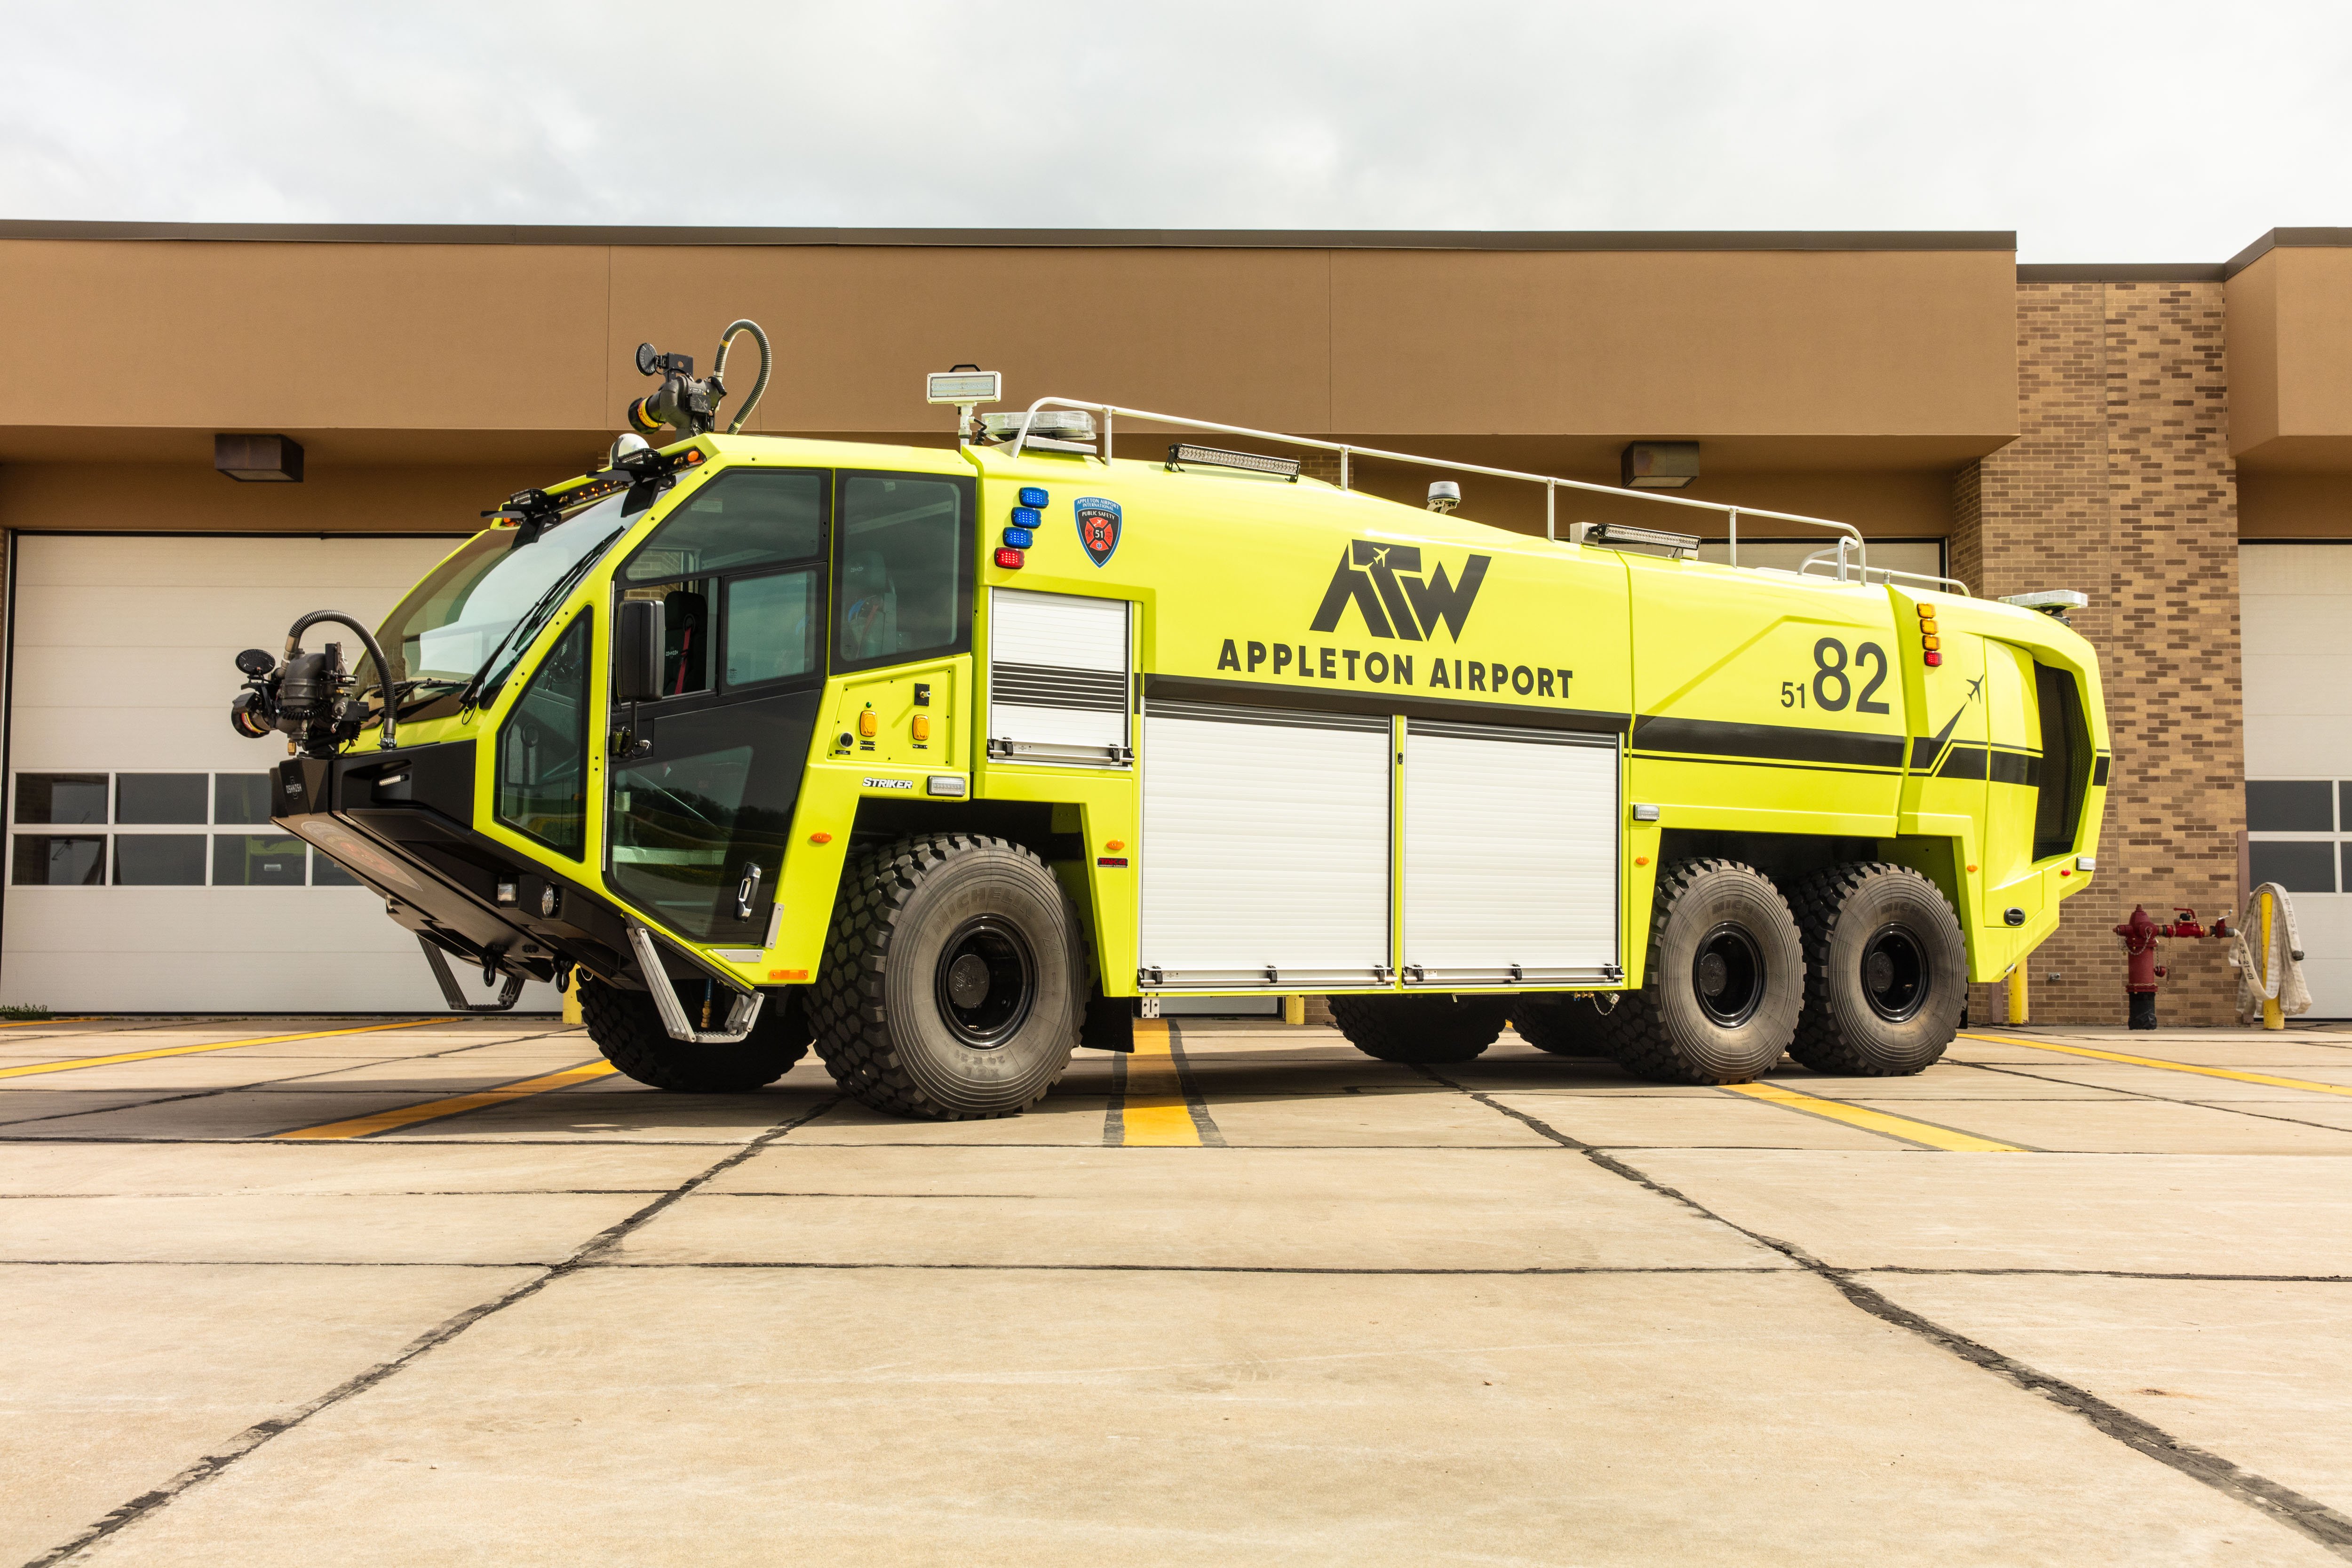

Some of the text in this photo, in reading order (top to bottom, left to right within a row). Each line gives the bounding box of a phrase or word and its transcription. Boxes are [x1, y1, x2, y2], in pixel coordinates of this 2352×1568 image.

[1082, 502, 1114, 511] INTERNATIONAL
[1100, 499, 1119, 510] AIRPORT
[1098, 511, 1115, 520] SAFETY
[1095, 530, 1103, 538] 51
[1309, 539, 1492, 644] ATW
[1217, 638, 1573, 699] APPLETON AIRPORT
[1780, 637, 1890, 715] 51 82
[286, 783, 302, 794] OSHKOSH
[862, 777, 913, 789] STRIKER
[932, 885, 1038, 936] MICHELIN
[2239, 943, 2254, 980] 2.5-21-01
